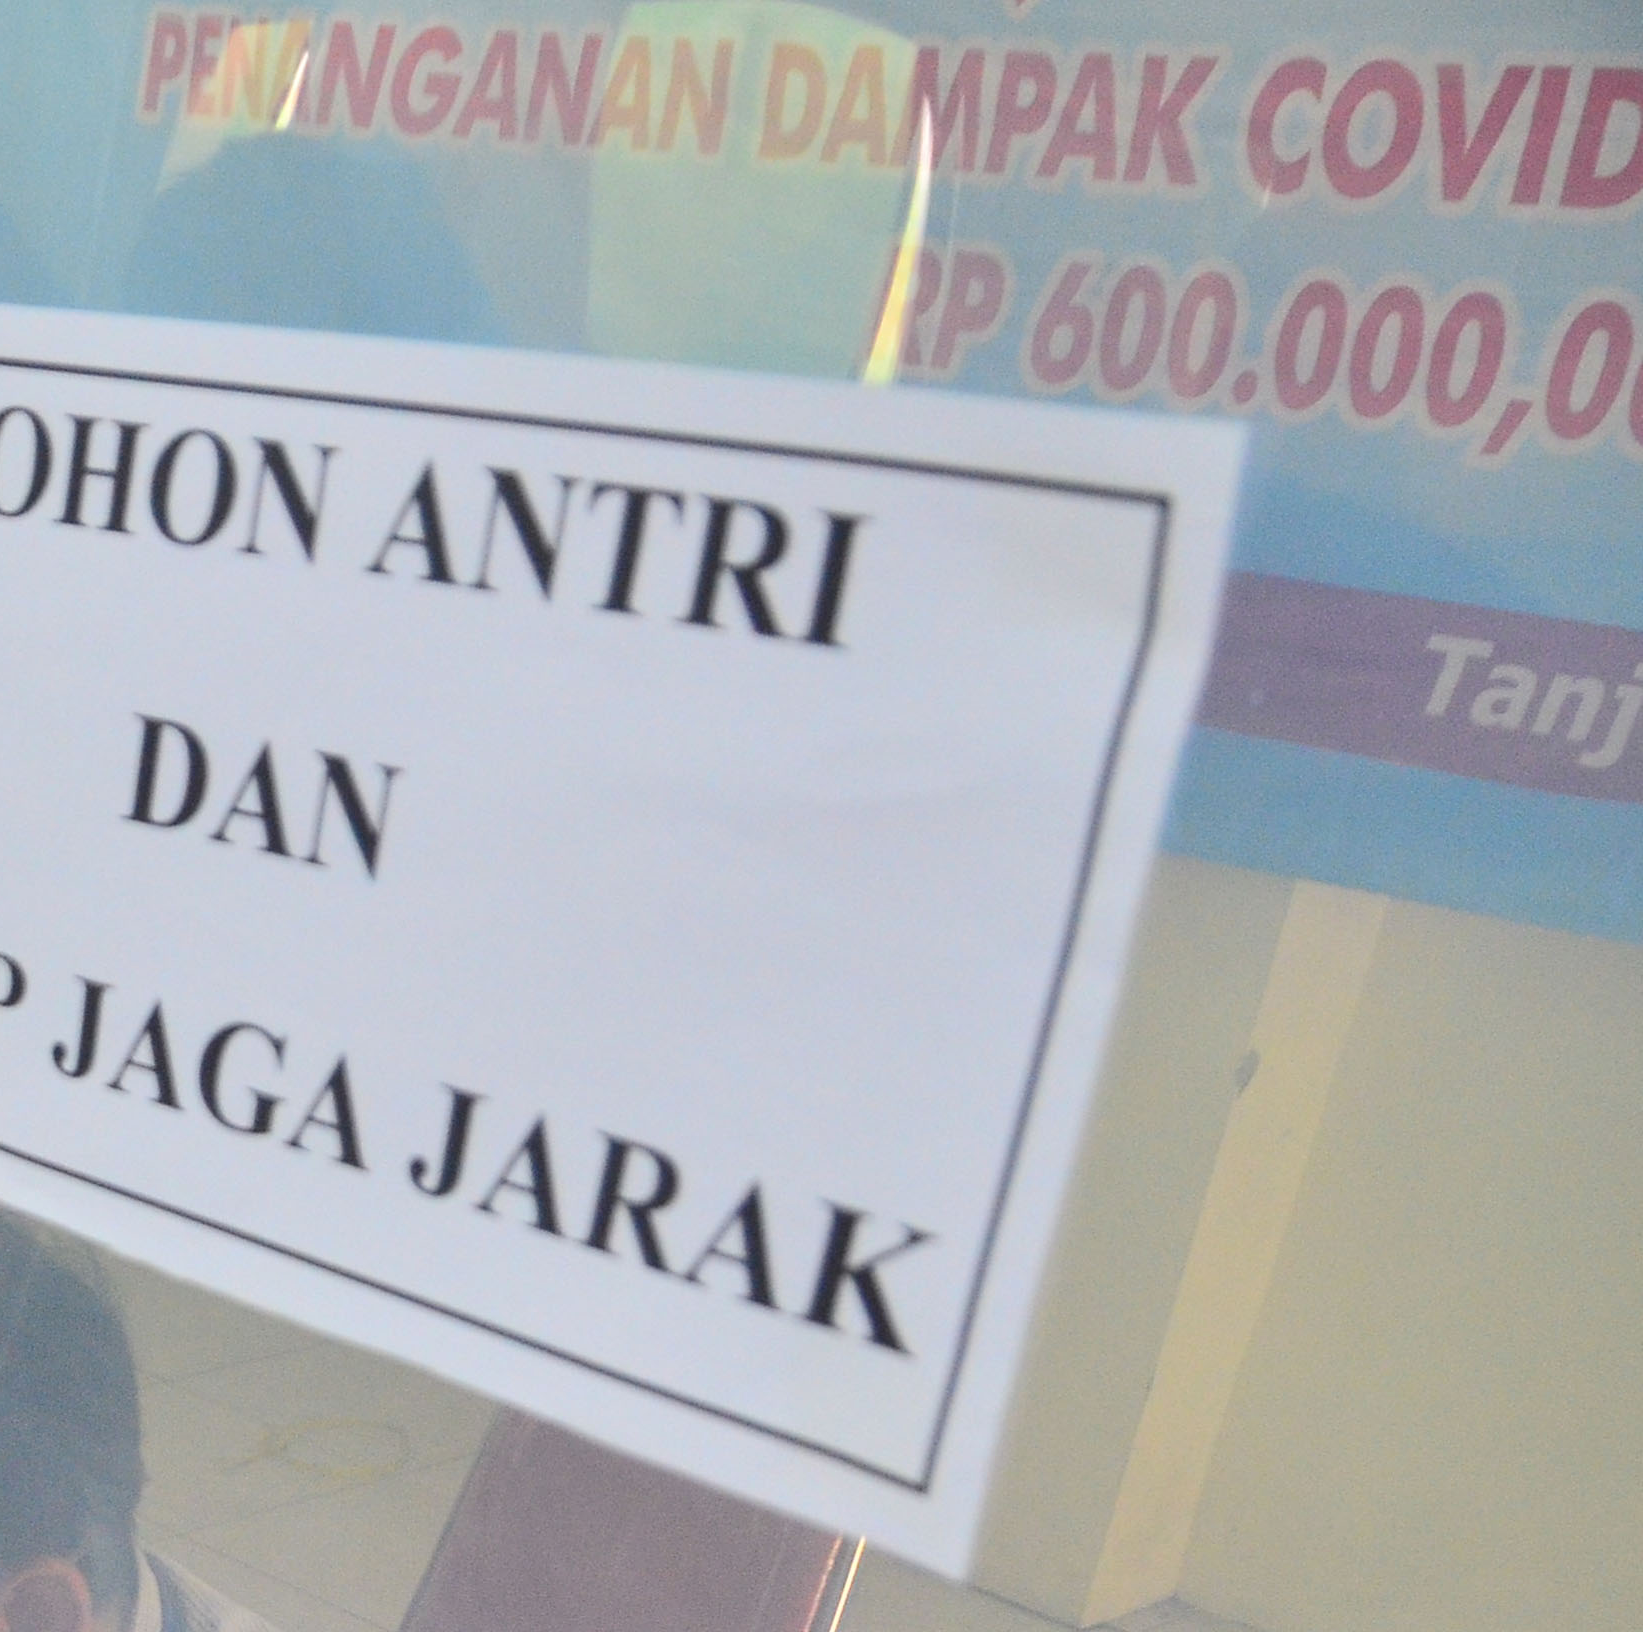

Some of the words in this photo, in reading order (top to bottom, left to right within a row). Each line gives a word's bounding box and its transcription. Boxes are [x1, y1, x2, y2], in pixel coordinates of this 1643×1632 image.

[141, 12, 735, 156] PENANGANAN
[758, 42, 1221, 187] DAMPAK
[1029, 262, 1643, 456] 600.000,0
[363, 459, 877, 650] ANTRI
[120, 712, 405, 883] DAN
[51, 974, 369, 1172] JAGA
[409, 1083, 938, 1356] JARAK
